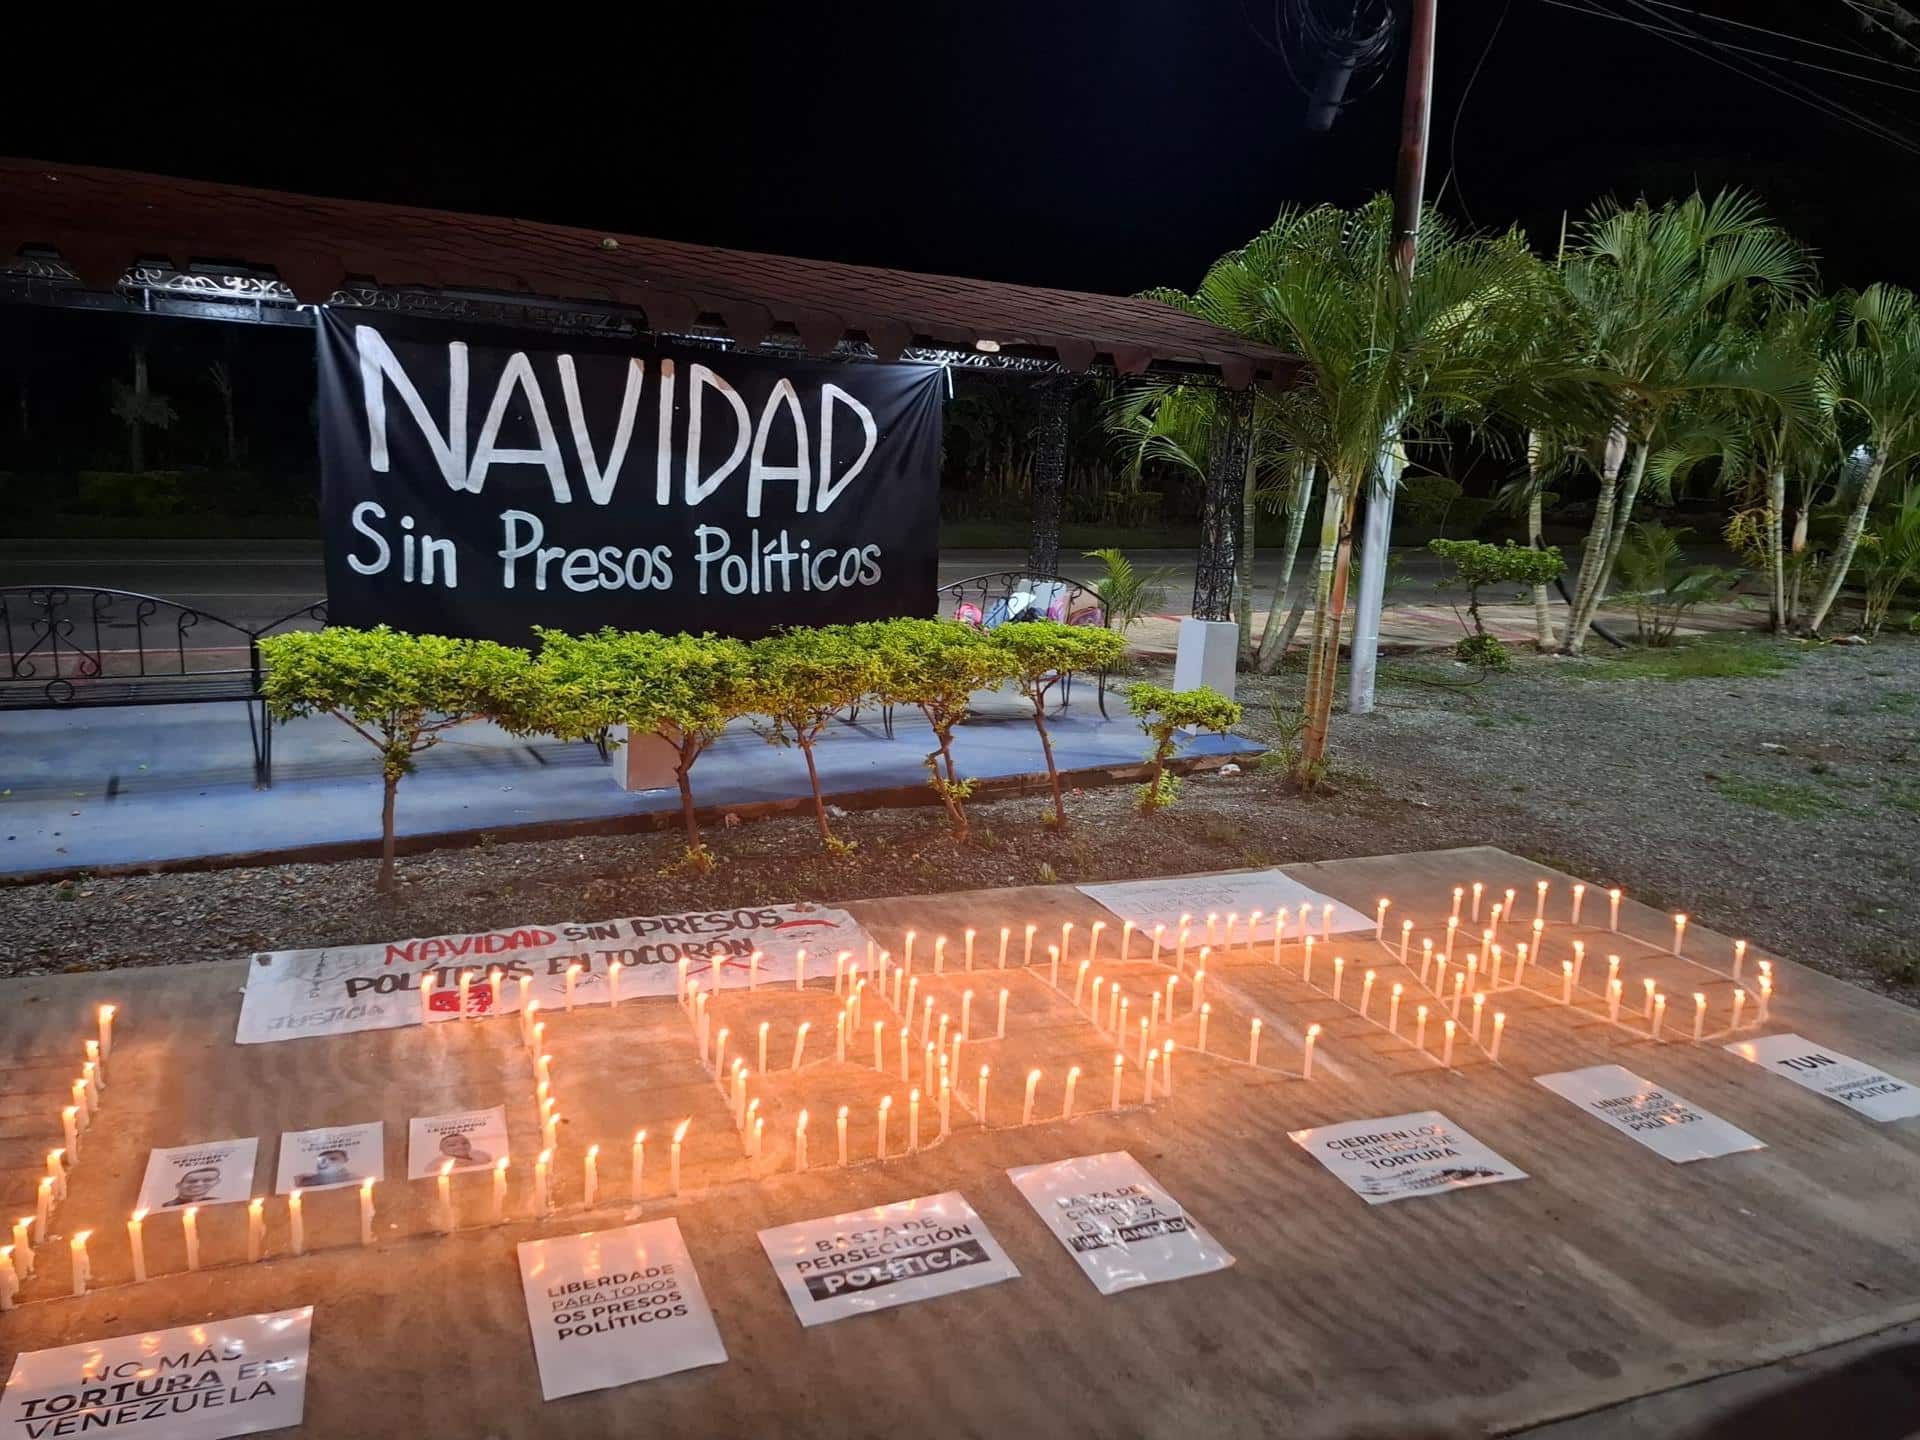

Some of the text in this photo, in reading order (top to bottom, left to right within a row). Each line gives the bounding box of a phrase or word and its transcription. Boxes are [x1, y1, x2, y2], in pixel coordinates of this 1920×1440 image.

[355, 324, 877, 517] NAVIDAD
[346, 501, 882, 594] Sin Presos Políticos
[383, 908, 785, 966] NAVIDAD SIN PRESOS
[547, 953, 591, 975] EN
[596, 935, 755, 968] TOCORÓN
[1777, 1053, 1838, 1072] TUN
[1326, 1130, 1408, 1150] CIERREN
[1340, 1141, 1430, 1161] CENTROS
[1366, 1149, 1459, 1169] TORTURA
[796, 1222, 972, 1274] PERSECUCIÓN
[816, 1215, 938, 1252] BASTA DE
[547, 1264, 676, 1297] LIBERDADE
[551, 1278, 678, 1312] PARA TODOS
[553, 1290, 683, 1325] OS PRESOS
[557, 1303, 688, 1341] POLÍTICOS
[20, 1369, 222, 1418] TORTURA
[24, 1380, 276, 1440] VENEZUELA
